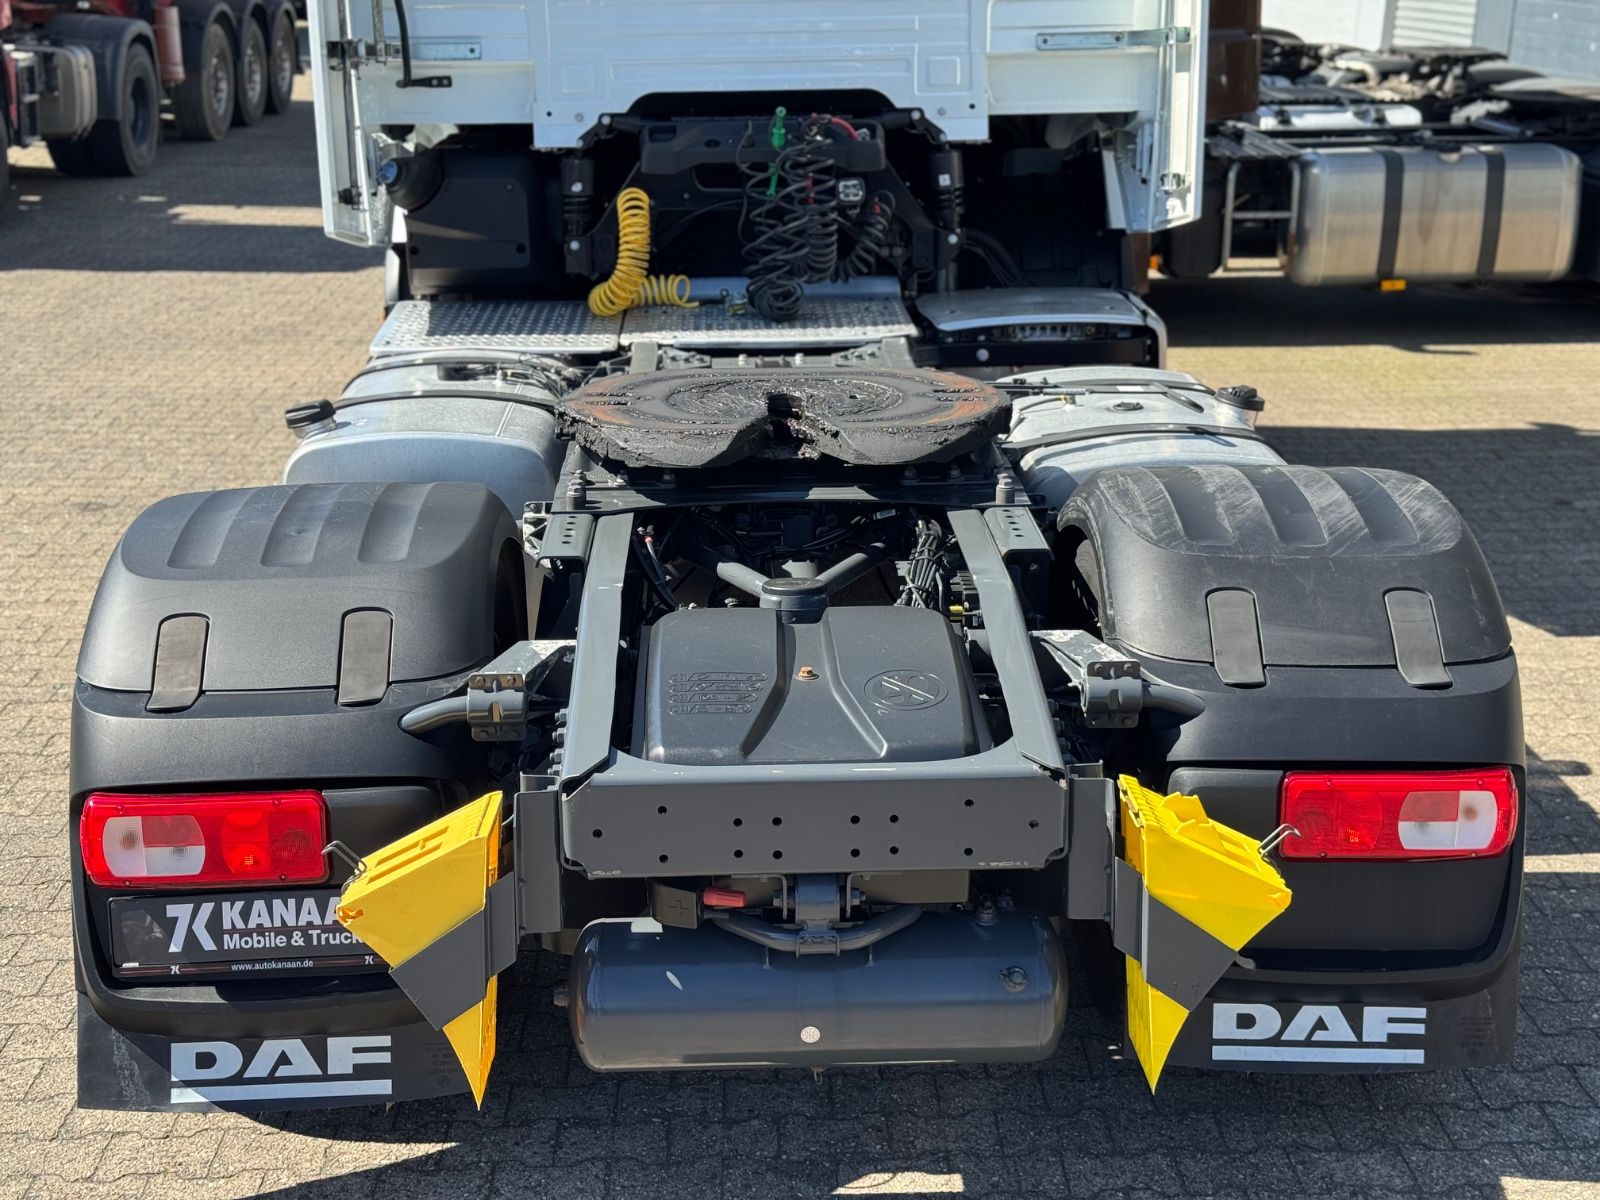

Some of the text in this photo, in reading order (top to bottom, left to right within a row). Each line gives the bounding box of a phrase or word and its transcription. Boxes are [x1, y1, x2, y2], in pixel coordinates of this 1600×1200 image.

[223, 930, 287, 950] Mobile
[290, 931, 306, 947] &
[231, 959, 314, 972] www.autokanaan.de
[1212, 1003, 1427, 1042] DAF
[171, 1035, 391, 1082] DAF
